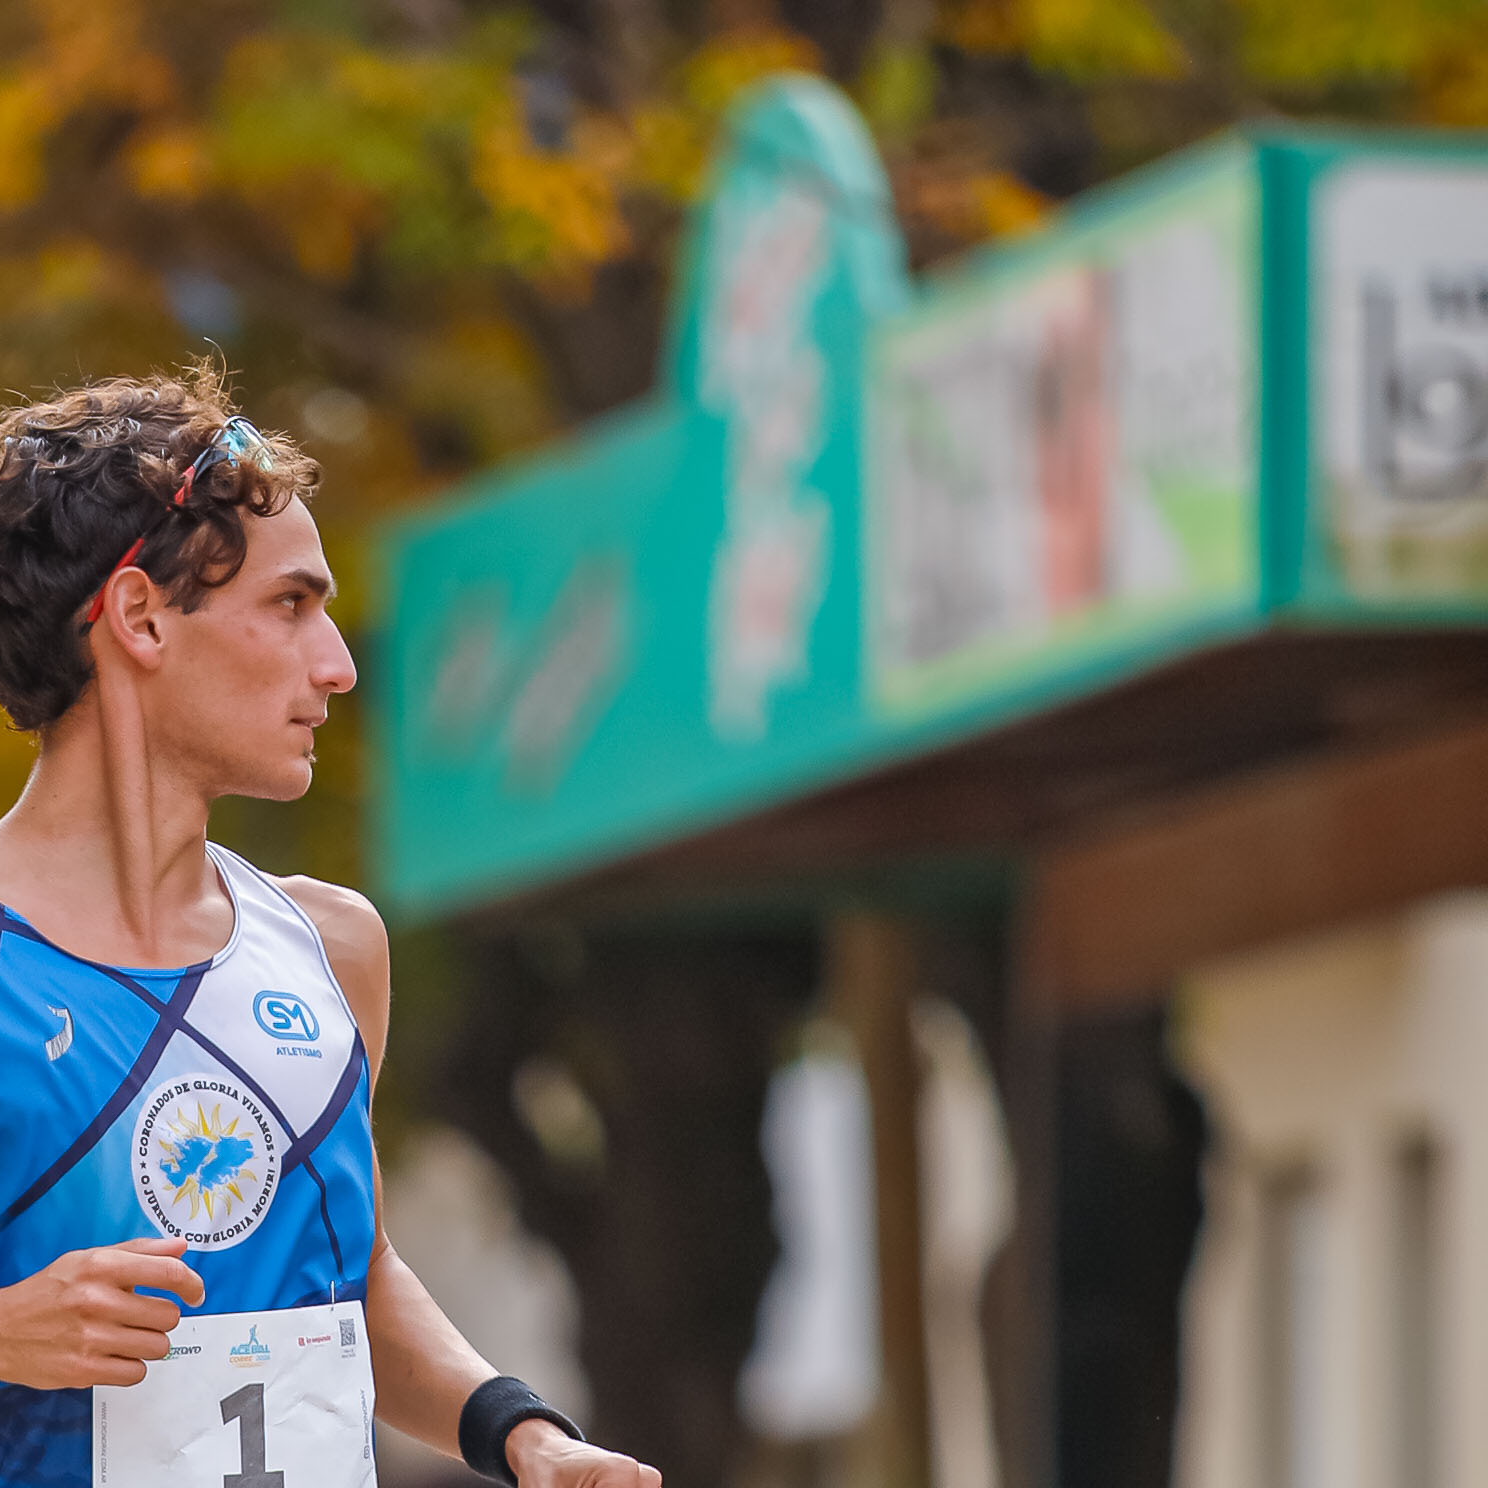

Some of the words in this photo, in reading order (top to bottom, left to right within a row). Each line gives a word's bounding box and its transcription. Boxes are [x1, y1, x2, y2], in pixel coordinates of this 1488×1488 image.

[276, 1047, 322, 1059] ATLETISMO
[139, 1089, 175, 1157] CORONADOS
[174, 1082, 191, 1095] DE
[193, 1080, 240, 1101] GLORIA
[241, 1095, 275, 1152] VIVAMOS
[140, 1174, 151, 1185] O
[184, 1232, 211, 1244] CON
[212, 1217, 254, 1243] GLORIA
